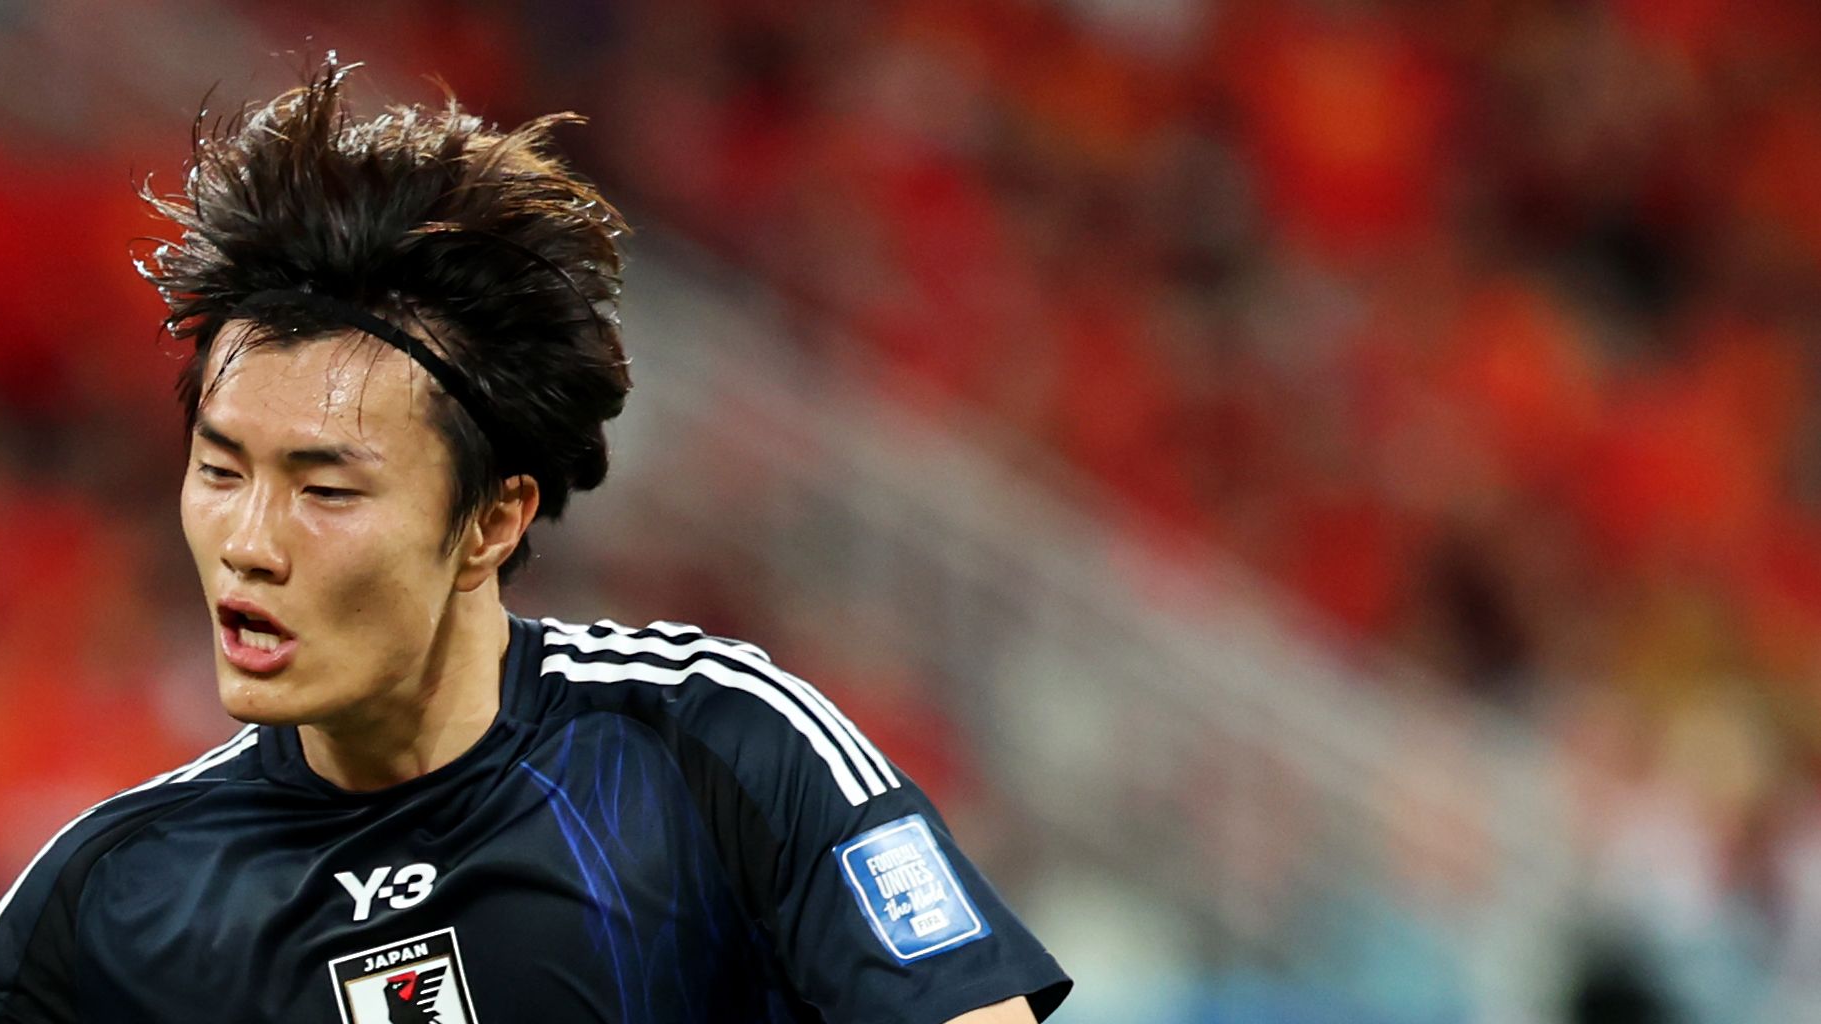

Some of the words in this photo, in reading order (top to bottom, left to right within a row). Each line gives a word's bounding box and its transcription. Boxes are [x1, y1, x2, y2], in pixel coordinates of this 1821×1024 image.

[334, 863, 437, 921] Y-3
[874, 859, 934, 899] UNITES
[883, 897, 913, 922] the
[917, 914, 941, 931] FIFA
[364, 942, 429, 972] JAPAN
